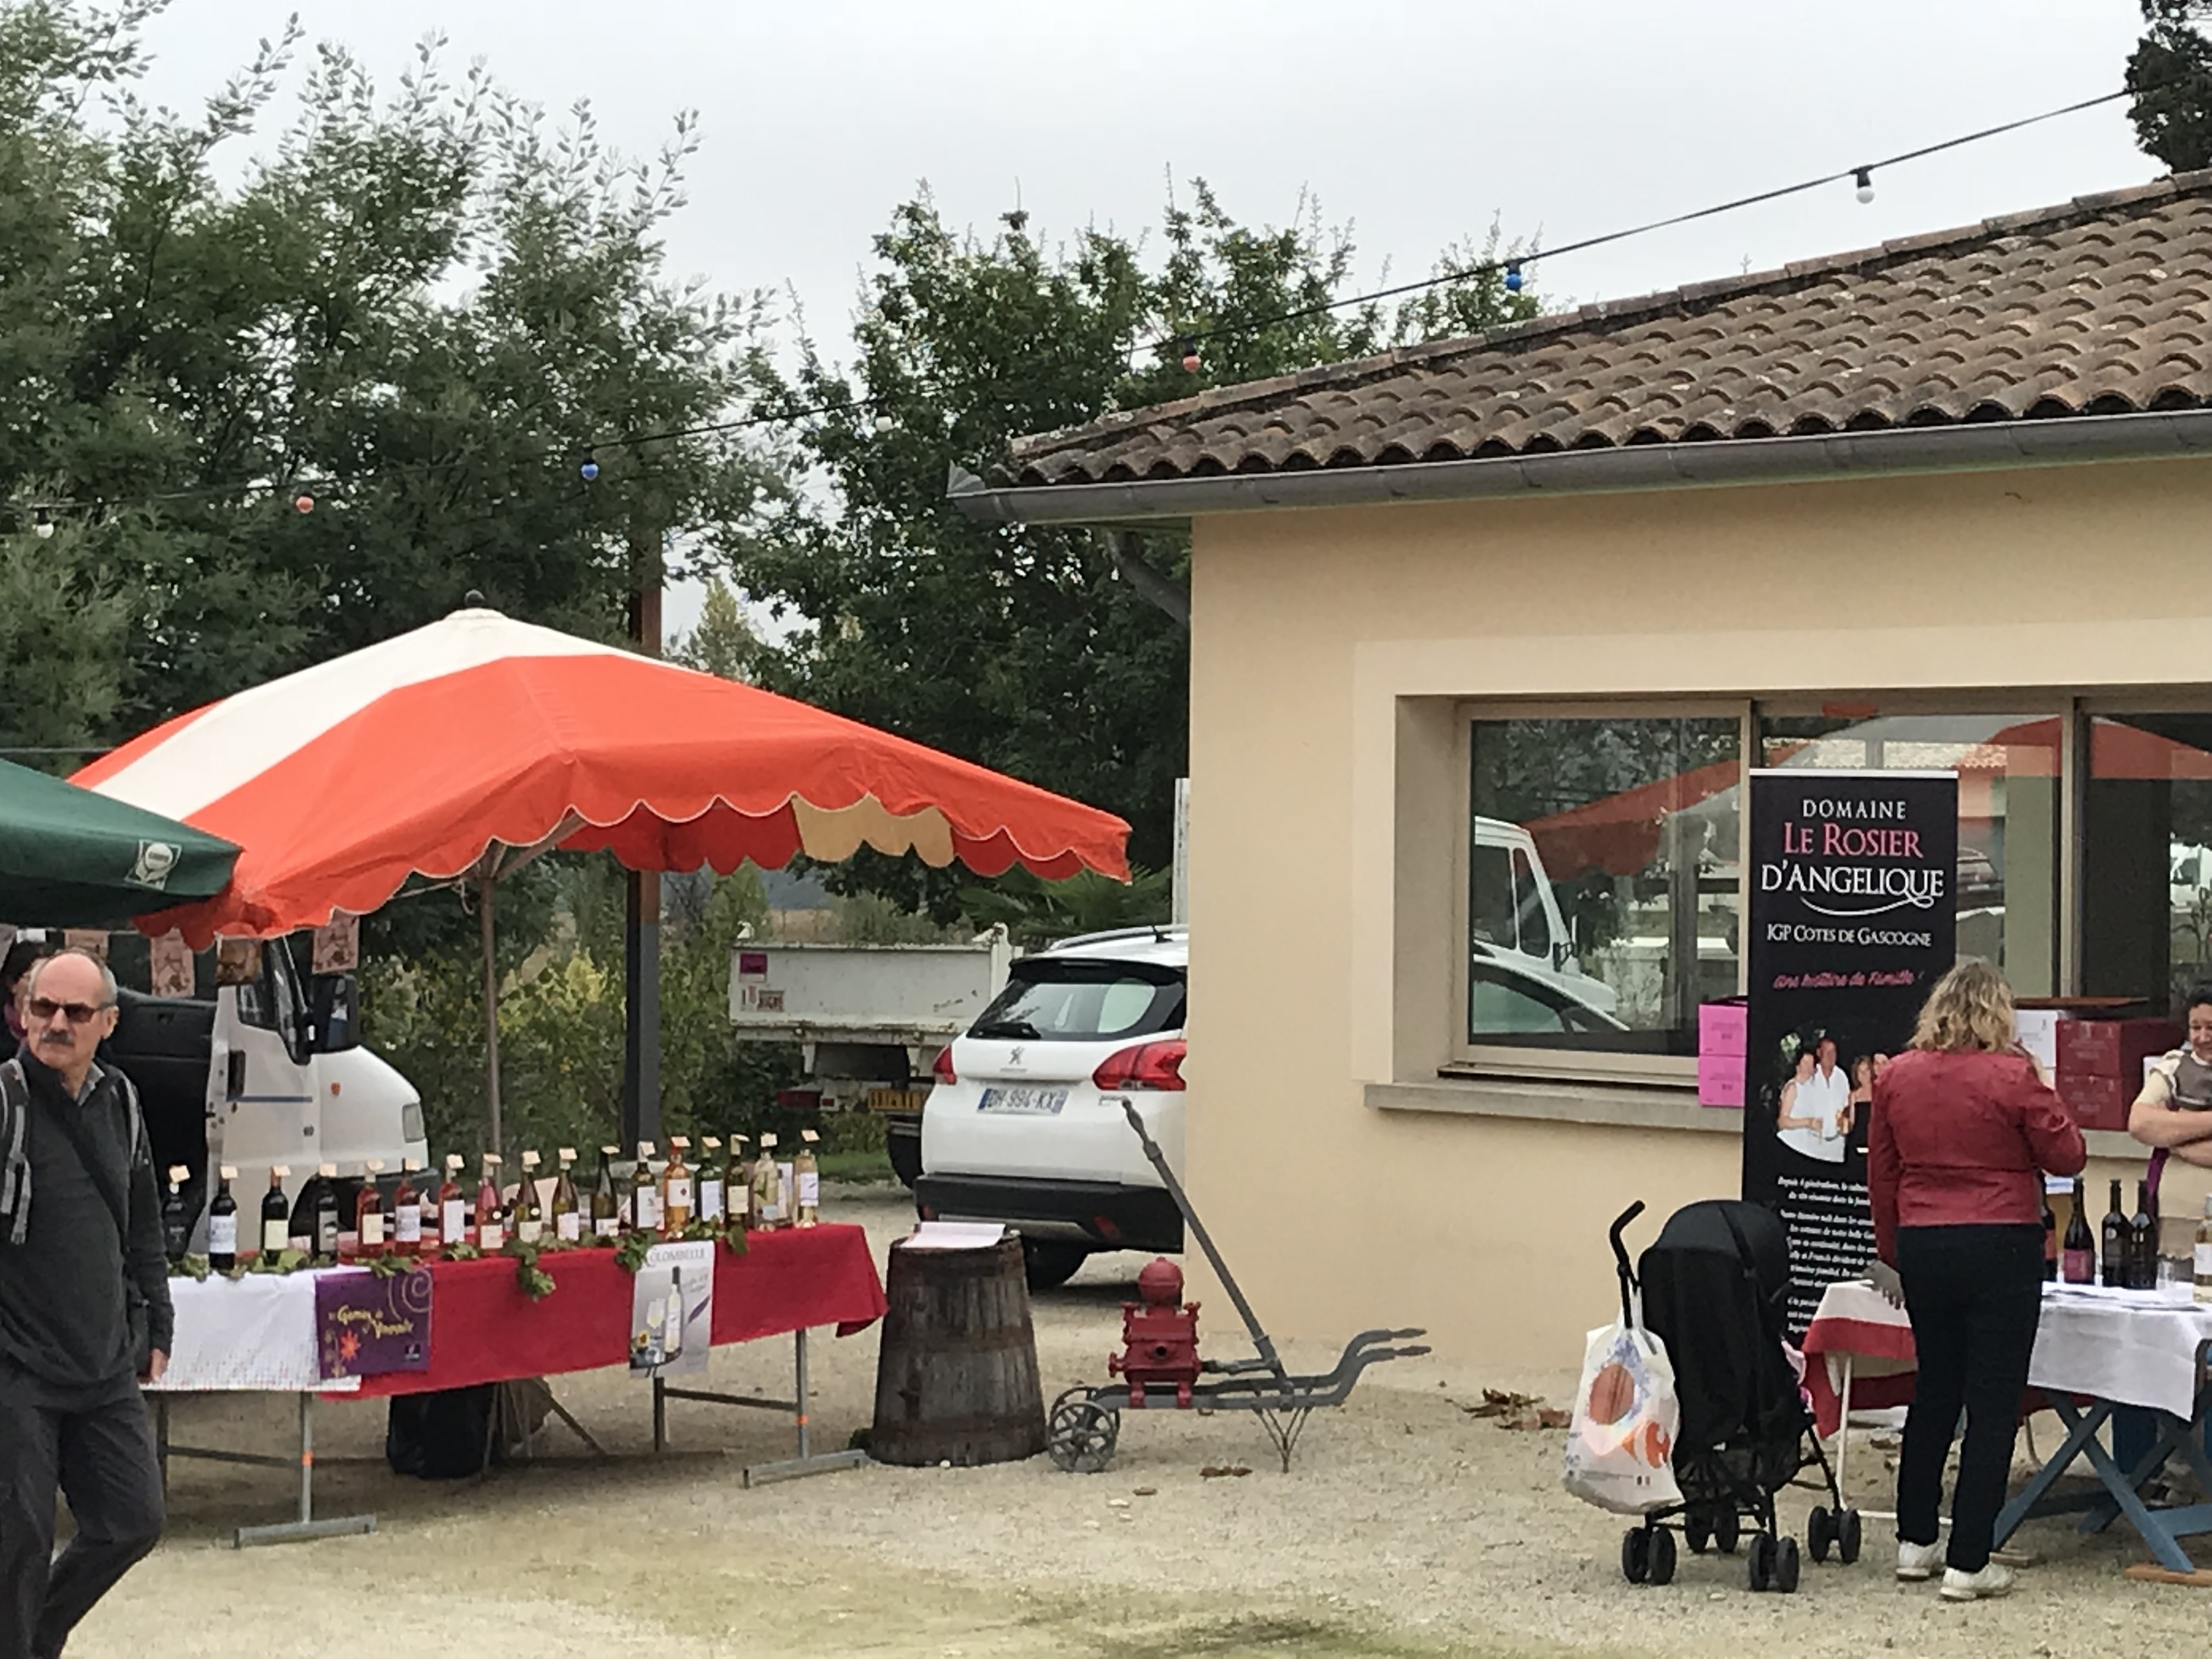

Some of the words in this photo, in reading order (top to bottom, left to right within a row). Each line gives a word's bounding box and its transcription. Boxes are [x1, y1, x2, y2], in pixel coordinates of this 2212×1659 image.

[1803, 799, 1906, 819] DOMAINE
[1767, 924, 1791, 941] IGP
[1857, 927, 1932, 947] GASCOGNE
